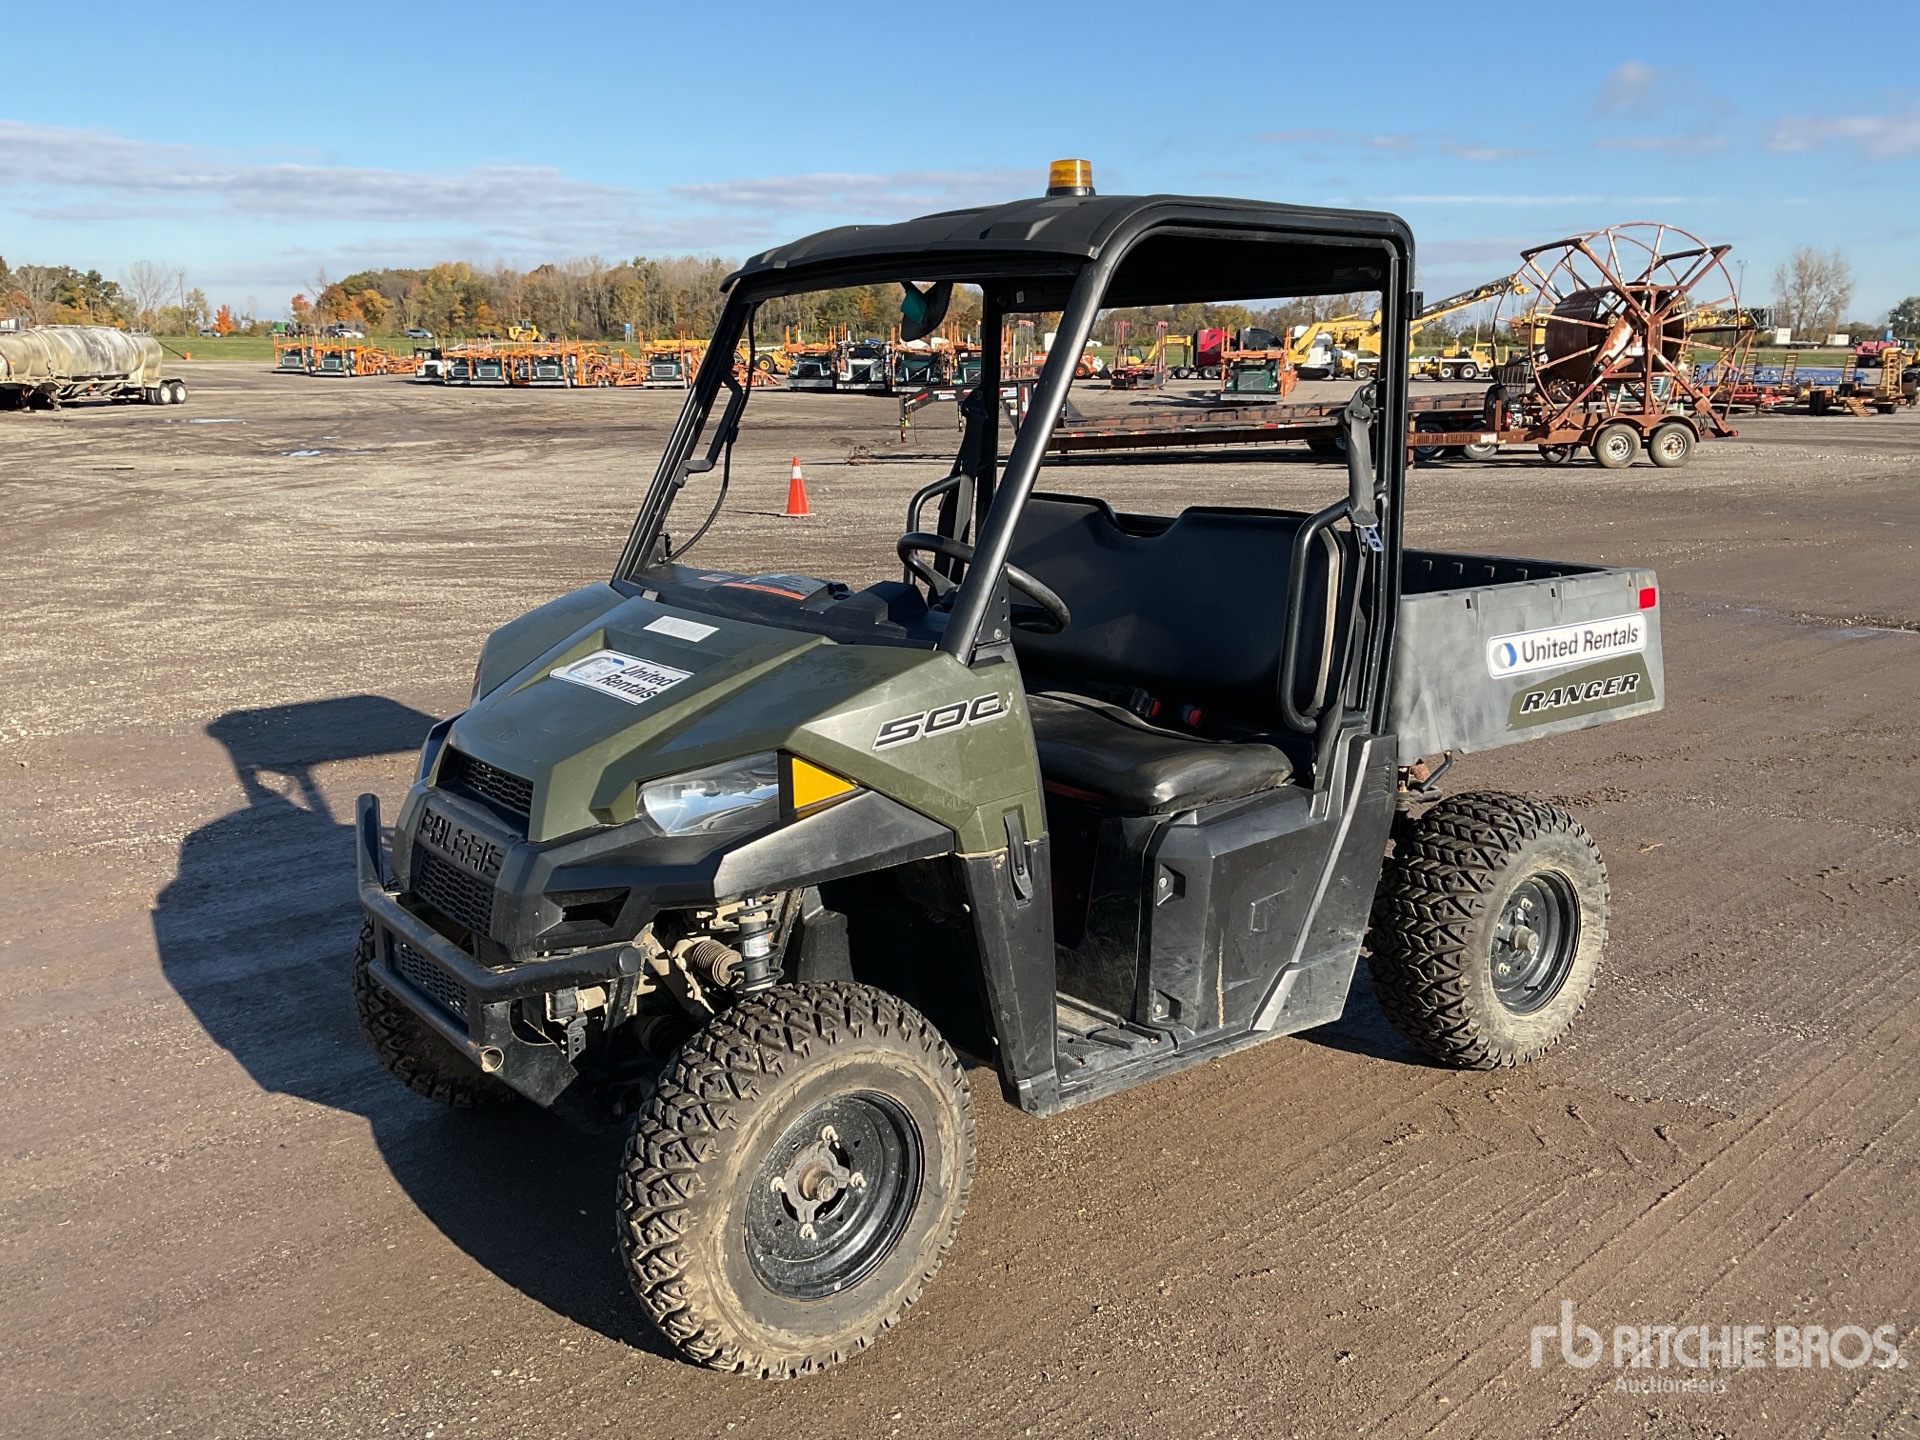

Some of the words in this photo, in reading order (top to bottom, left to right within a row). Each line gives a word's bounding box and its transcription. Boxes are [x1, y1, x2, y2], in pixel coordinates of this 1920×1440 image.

[1521, 631, 1578, 663] United
[1583, 623, 1639, 653] Rentals
[597, 674, 658, 699] Rentals
[620, 665, 682, 688] United
[1519, 673, 1640, 714] RANGER
[419, 807, 504, 873] POLARIS
